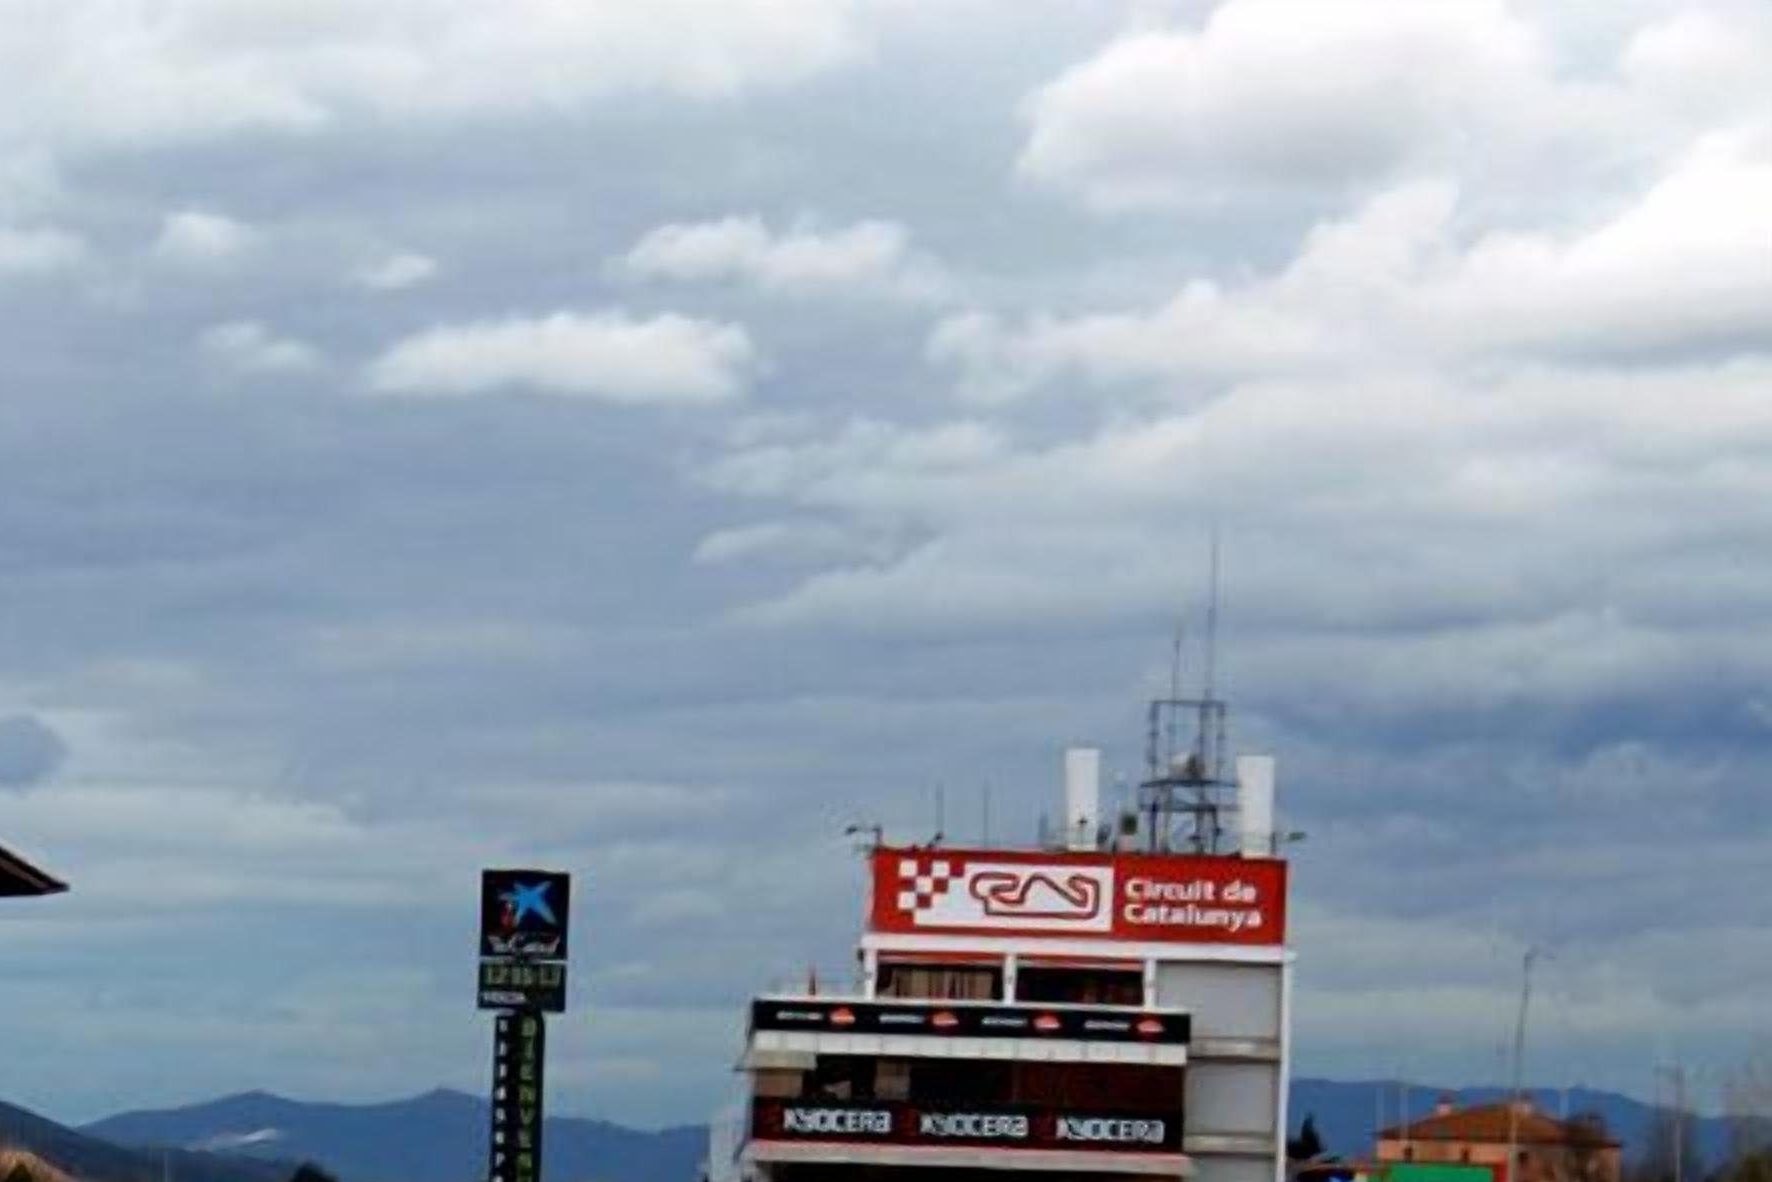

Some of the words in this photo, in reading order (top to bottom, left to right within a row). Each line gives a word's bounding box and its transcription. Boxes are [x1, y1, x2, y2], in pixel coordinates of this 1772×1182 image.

[1125, 878, 1214, 901] Circuit
[1222, 878, 1257, 902] de
[1124, 903, 1263, 932] Catalunya
[783, 1108, 892, 1133] KYOCERA
[920, 1112, 1029, 1137] KYOCERA
[1056, 1116, 1165, 1143] KYOCERA
